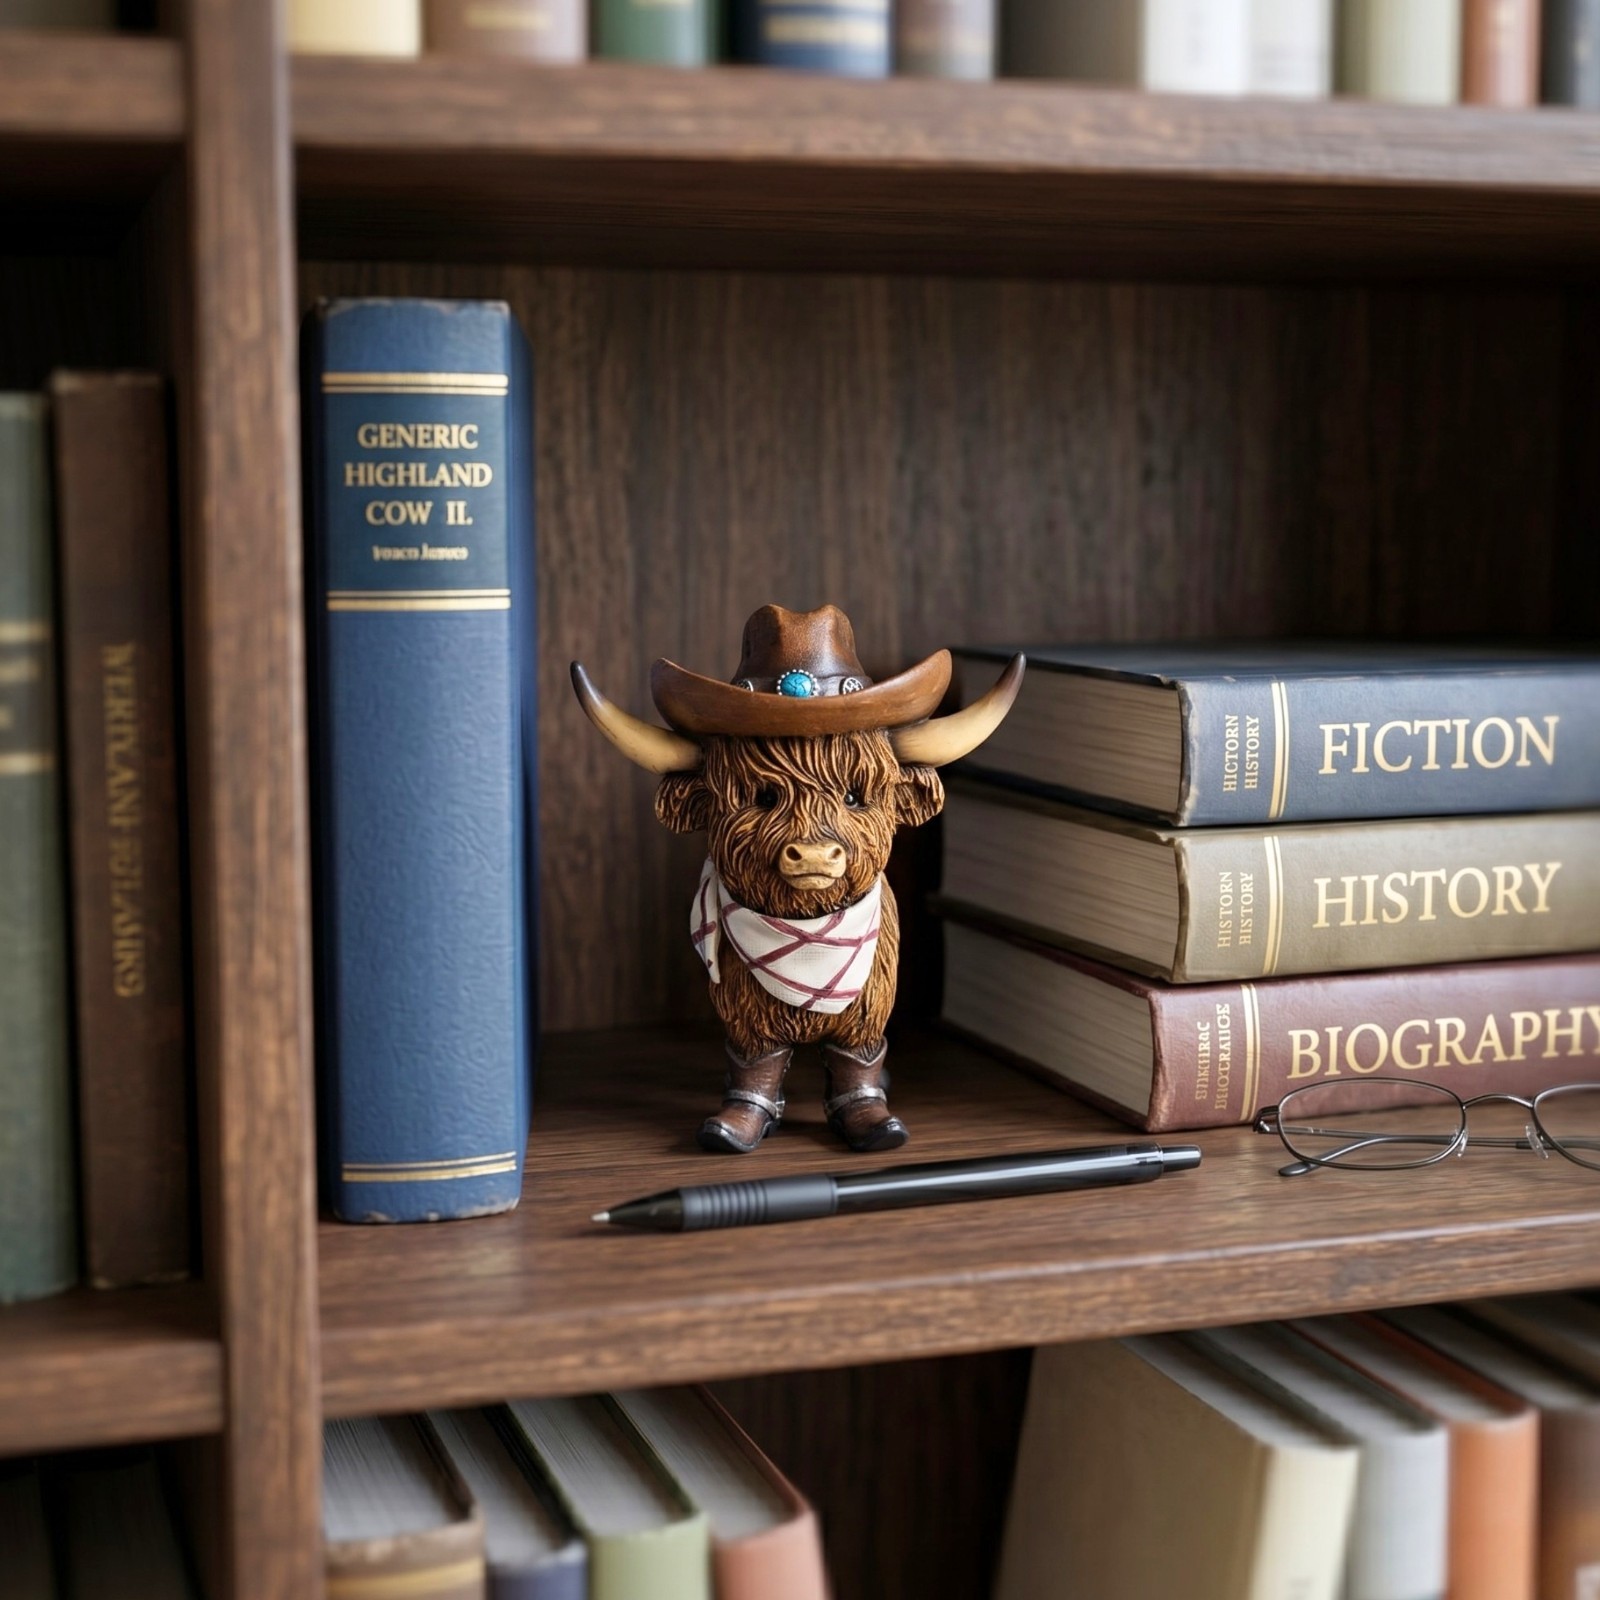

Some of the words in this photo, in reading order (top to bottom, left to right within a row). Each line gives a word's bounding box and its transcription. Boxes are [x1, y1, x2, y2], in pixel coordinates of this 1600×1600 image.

[357, 423, 479, 449] GENERIC
[344, 462, 493, 487] HIGHLAND
[366, 501, 433, 525] COW
[1223, 714, 1239, 792] HICTORN
[1244, 715, 1260, 789] HISTORY
[1318, 715, 1560, 775] FICTION
[1217, 871, 1232, 948] HISTORN
[1239, 872, 1253, 945] HISTORY
[1312, 862, 1562, 928] HISTORY
